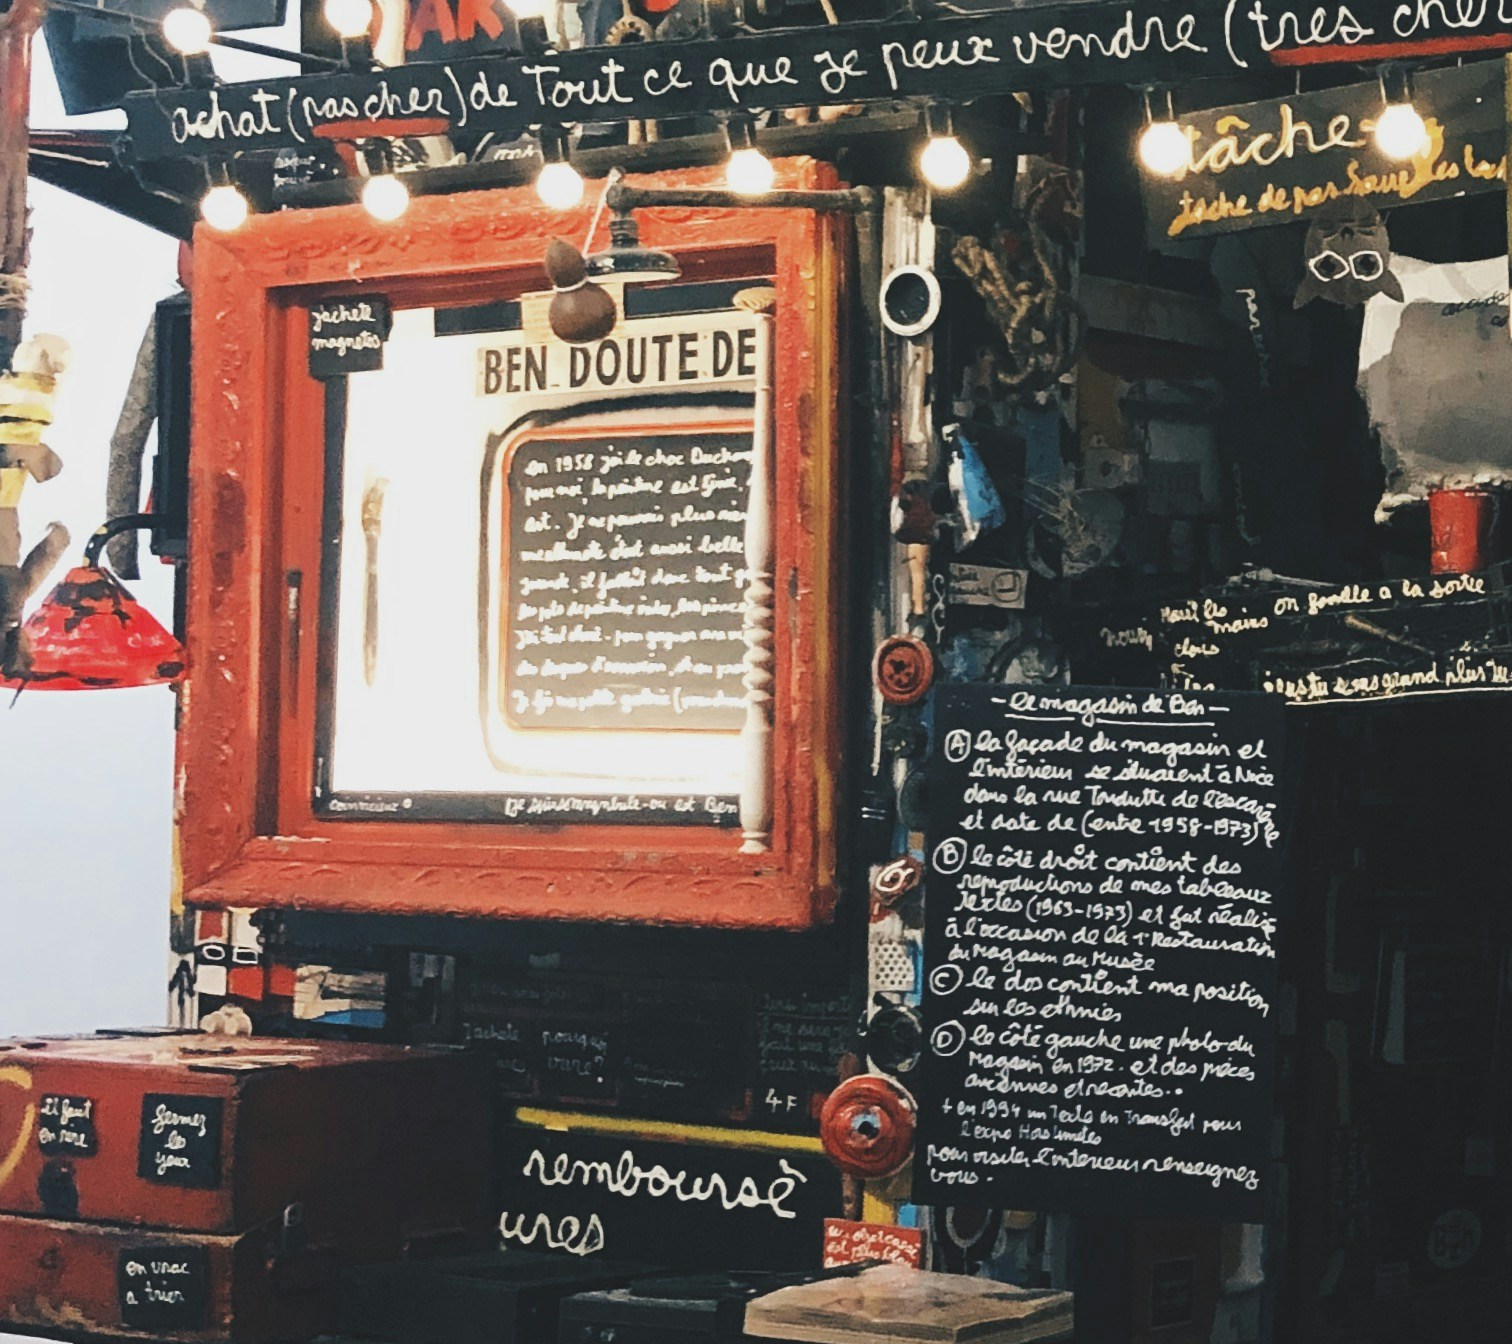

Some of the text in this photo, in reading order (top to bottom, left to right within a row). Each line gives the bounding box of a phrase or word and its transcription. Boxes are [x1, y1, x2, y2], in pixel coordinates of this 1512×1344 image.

[172, 86, 282, 146] achat
[470, 71, 510, 109] de
[527, 64, 631, 110] Tout
[642, 58, 692, 96] ce
[708, 57, 798, 106] que
[882, 38, 1000, 91] peux
[1012, 6, 1209, 64] vendre
[483, 328, 758, 395] BEN DOUTE DE
[974, 729, 1003, 751] la
[1089, 731, 1118, 754] du
[1121, 733, 1231, 767] magasin
[1237, 739, 1267, 760] et
[963, 786, 1007, 806] dans
[1013, 785, 1039, 806] la
[958, 812, 985, 831] et
[1047, 814, 1078, 833] de
[971, 844, 994, 867] le
[1104, 845, 1198, 874] contient
[1202, 855, 1242, 876] des
[1099, 875, 1124, 895] de
[1130, 880, 1172, 895] mes
[1137, 904, 1164, 925] et
[1071, 925, 1099, 946] de
[965, 966, 995, 989] le
[1004, 968, 1044, 992] dos
[1047, 968, 1143, 996] contient
[963, 997, 1000, 1017] sur
[1003, 997, 1037, 1018] les
[968, 1024, 996, 1047] le
[1046, 1027, 1126, 1060] gauche
[1130, 1055, 1159, 1077] et
[1161, 1057, 1198, 1077] des
